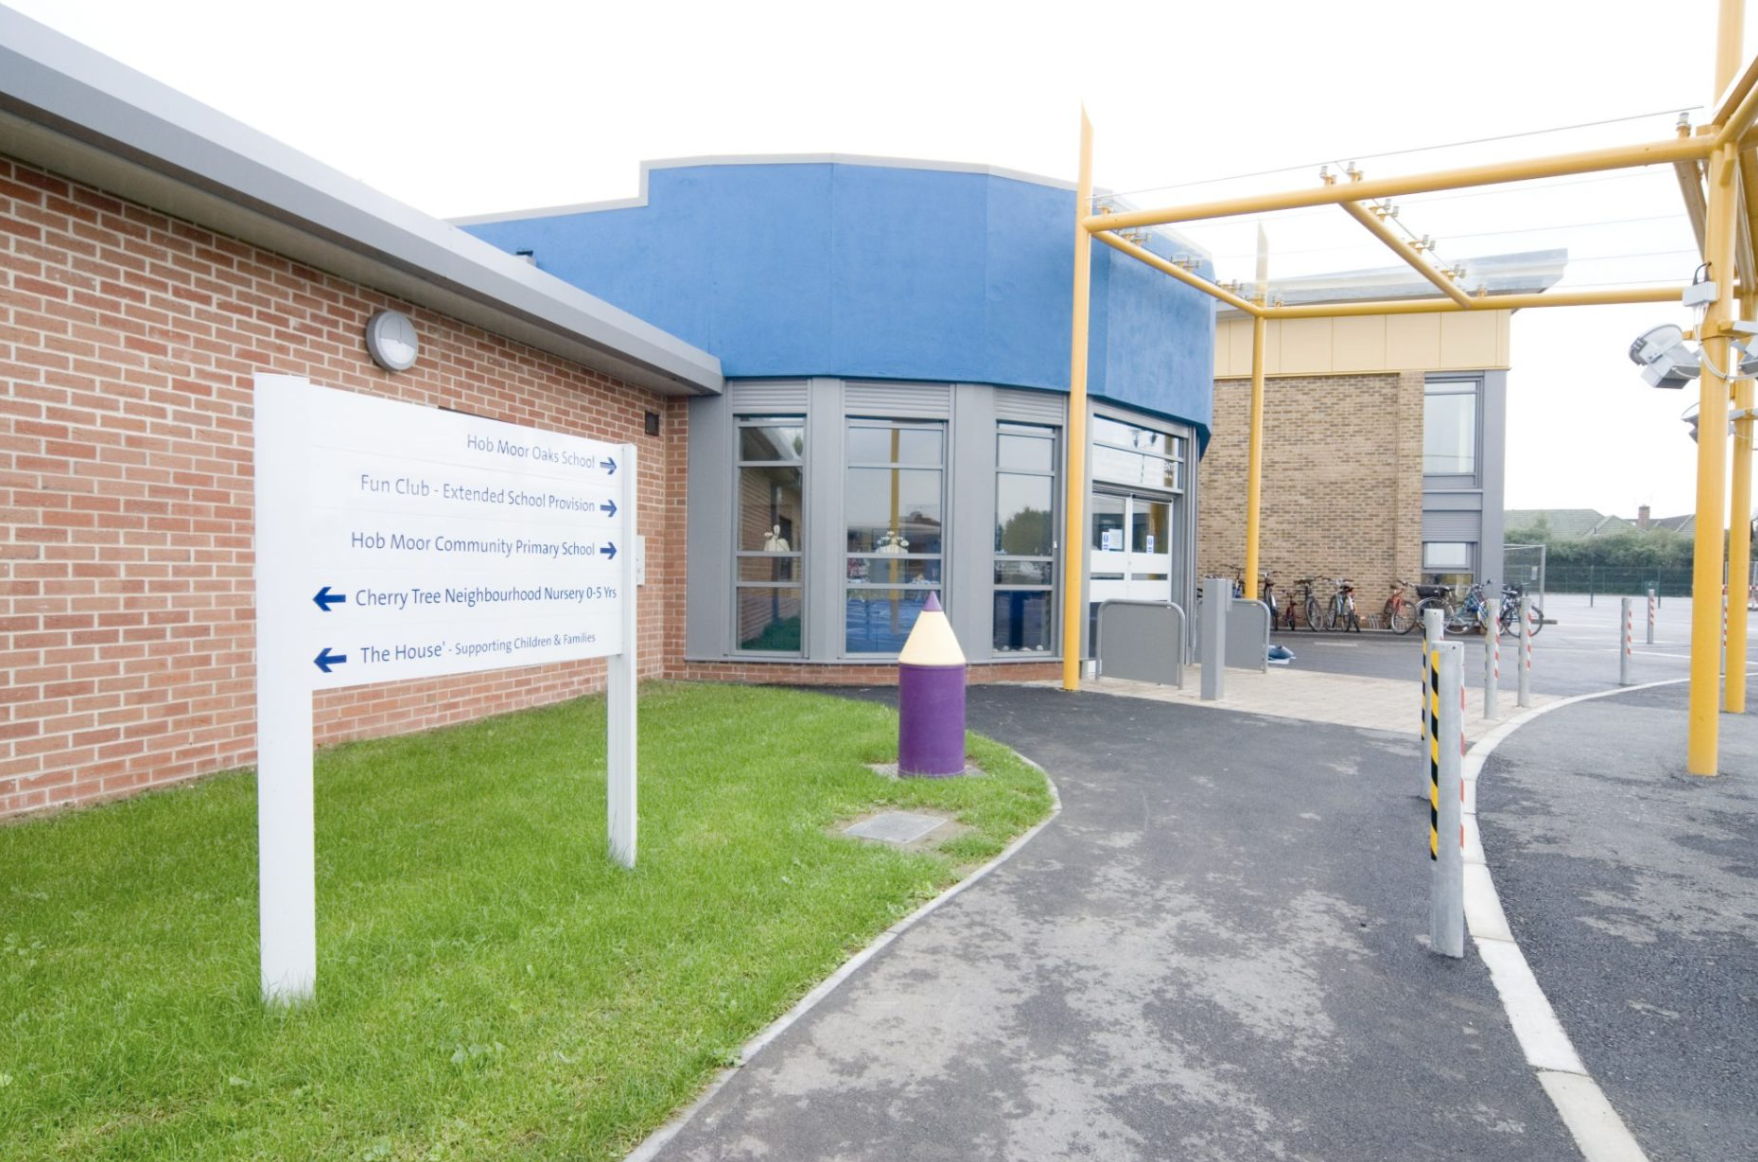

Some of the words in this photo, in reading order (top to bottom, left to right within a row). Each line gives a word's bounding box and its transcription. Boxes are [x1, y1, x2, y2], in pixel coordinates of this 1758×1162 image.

[466, 434, 494, 453] Hob
[496, 440, 530, 459] Moor
[531, 446, 559, 464] Oaks
[561, 450, 596, 469] School
[360, 474, 391, 494] Fun
[394, 477, 430, 498] Club
[442, 483, 505, 504] Extended
[507, 490, 546, 508] School
[548, 495, 596, 512] Provision
[350, 531, 386, 550] Hob
[389, 534, 432, 551] Moor
[434, 536, 514, 559] Community
[515, 539, 560, 560] Primary
[561, 541, 596, 556] School
[355, 588, 409, 611] Cherry
[410, 588, 442, 605] Tree
[444, 586, 542, 608] Neighbourhood
[543, 586, 585, 604] Nursery
[585, 586, 603, 600] 0-5
[603, 586, 617, 599] Yrs
[359, 646, 391, 664] The
[454, 641, 512, 658] Supporting
[513, 635, 552, 651] Children
[553, 633, 562, 647] &
[562, 632, 597, 646] Families
